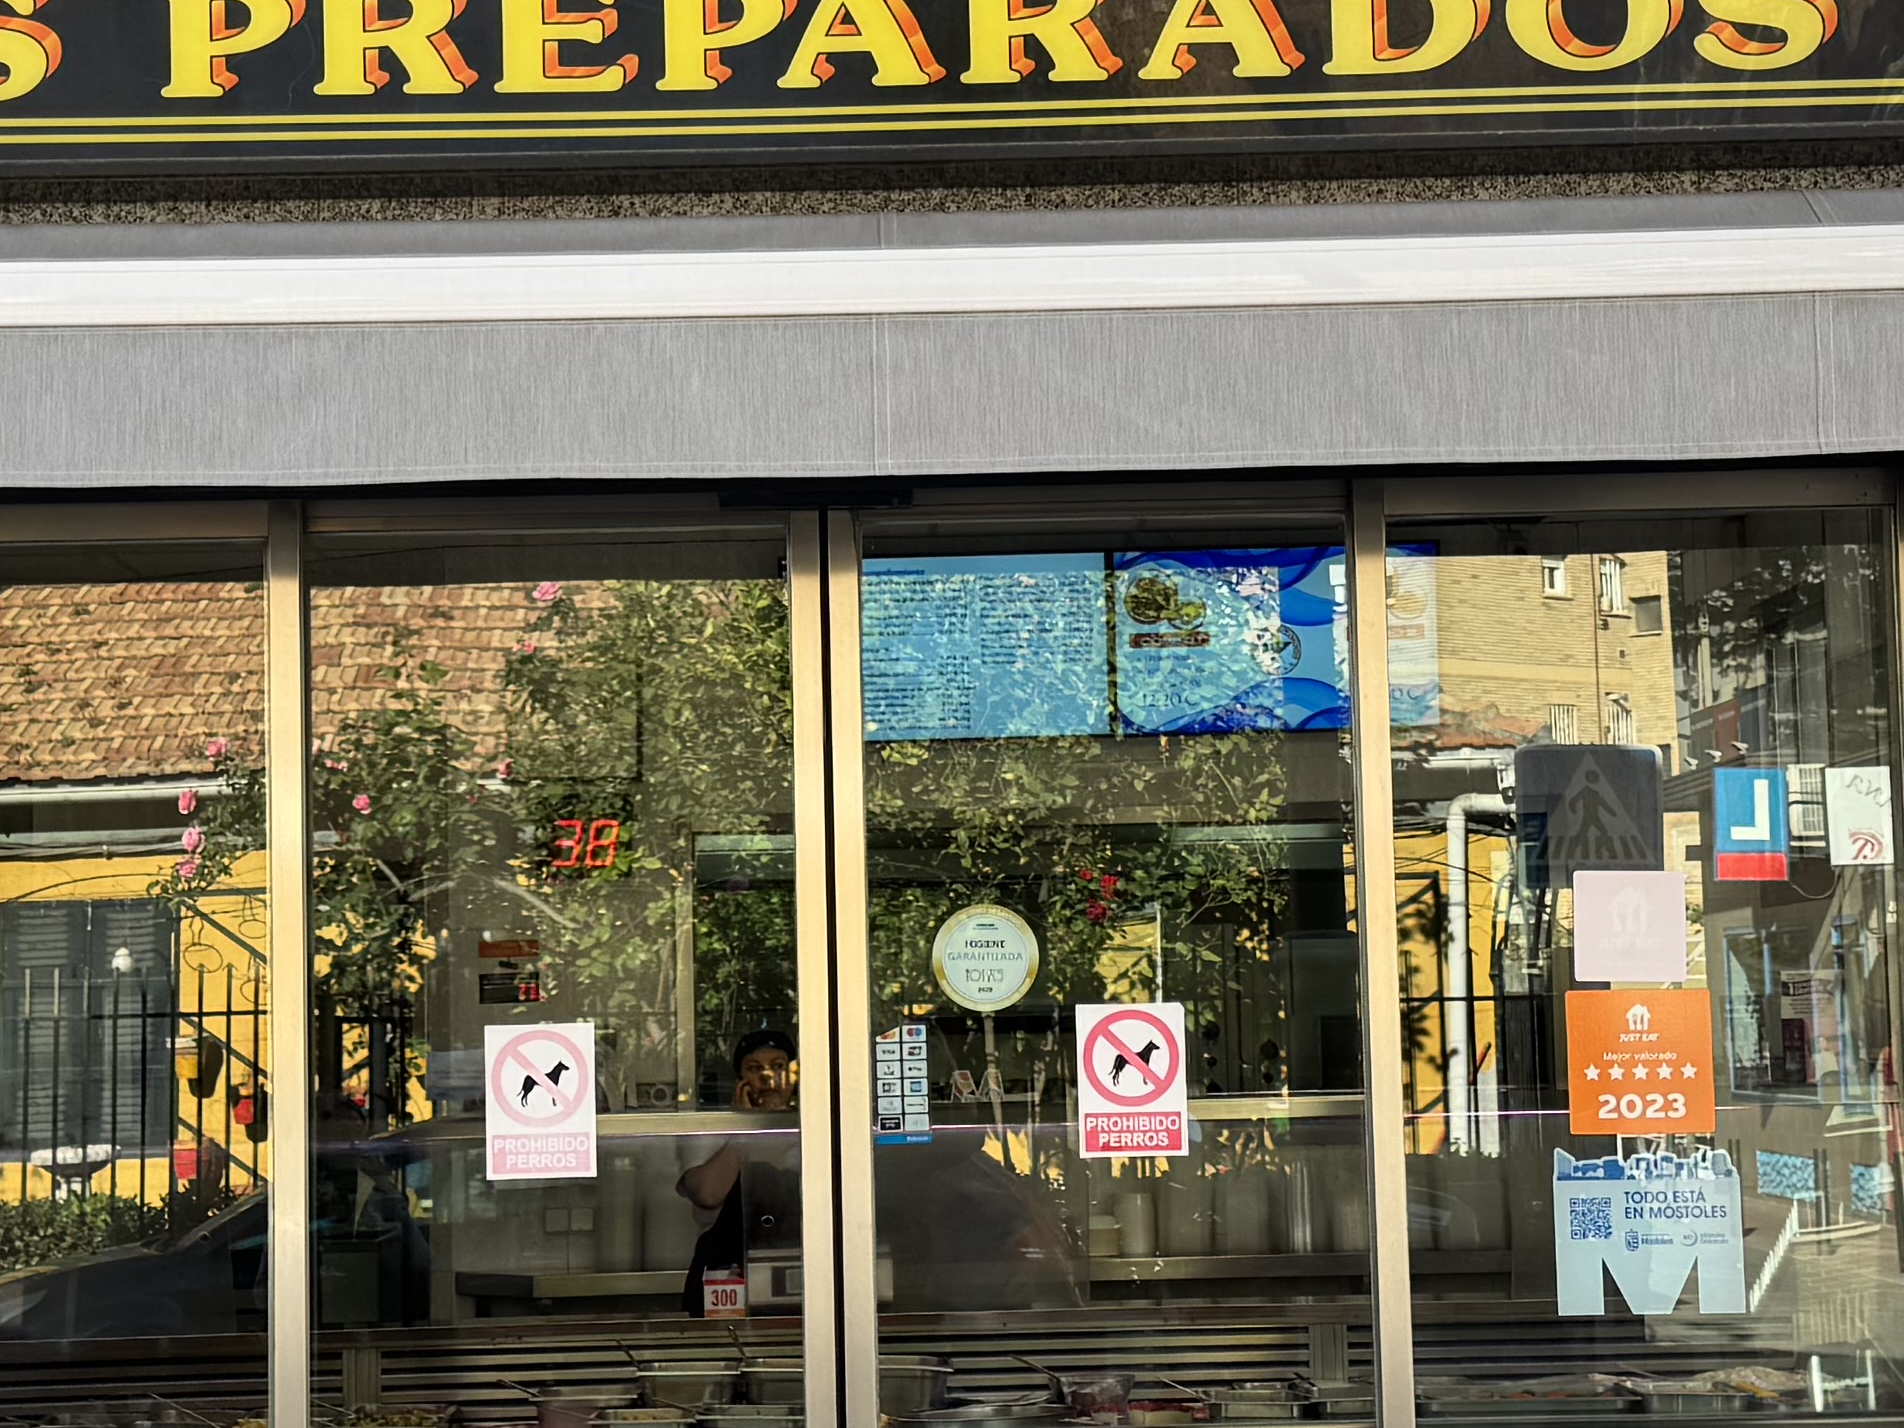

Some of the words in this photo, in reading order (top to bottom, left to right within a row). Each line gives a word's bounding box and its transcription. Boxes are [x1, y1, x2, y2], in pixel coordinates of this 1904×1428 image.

[551, 819, 620, 866] 38
[1619, 1033, 1640, 1042] JUST
[1642, 1033, 1659, 1042] EAT
[1603, 1052, 1631, 1063] Mejor
[1634, 1051, 1677, 1060] valorado
[1598, 1093, 1687, 1119] 2023
[1086, 1115, 1180, 1131] PROHIBIDO
[494, 1137, 589, 1153] PROHIBIDO
[1099, 1131, 1169, 1147] PERROS
[506, 1154, 577, 1169] PERROS
[1624, 1190, 1668, 1204] TODO
[1673, 1186, 1706, 1203] ESTÁ
[1625, 1206, 1644, 1220] EN
[1649, 1201, 1727, 1219] MÓSTOLES
[711, 1289, 738, 1307] 300
